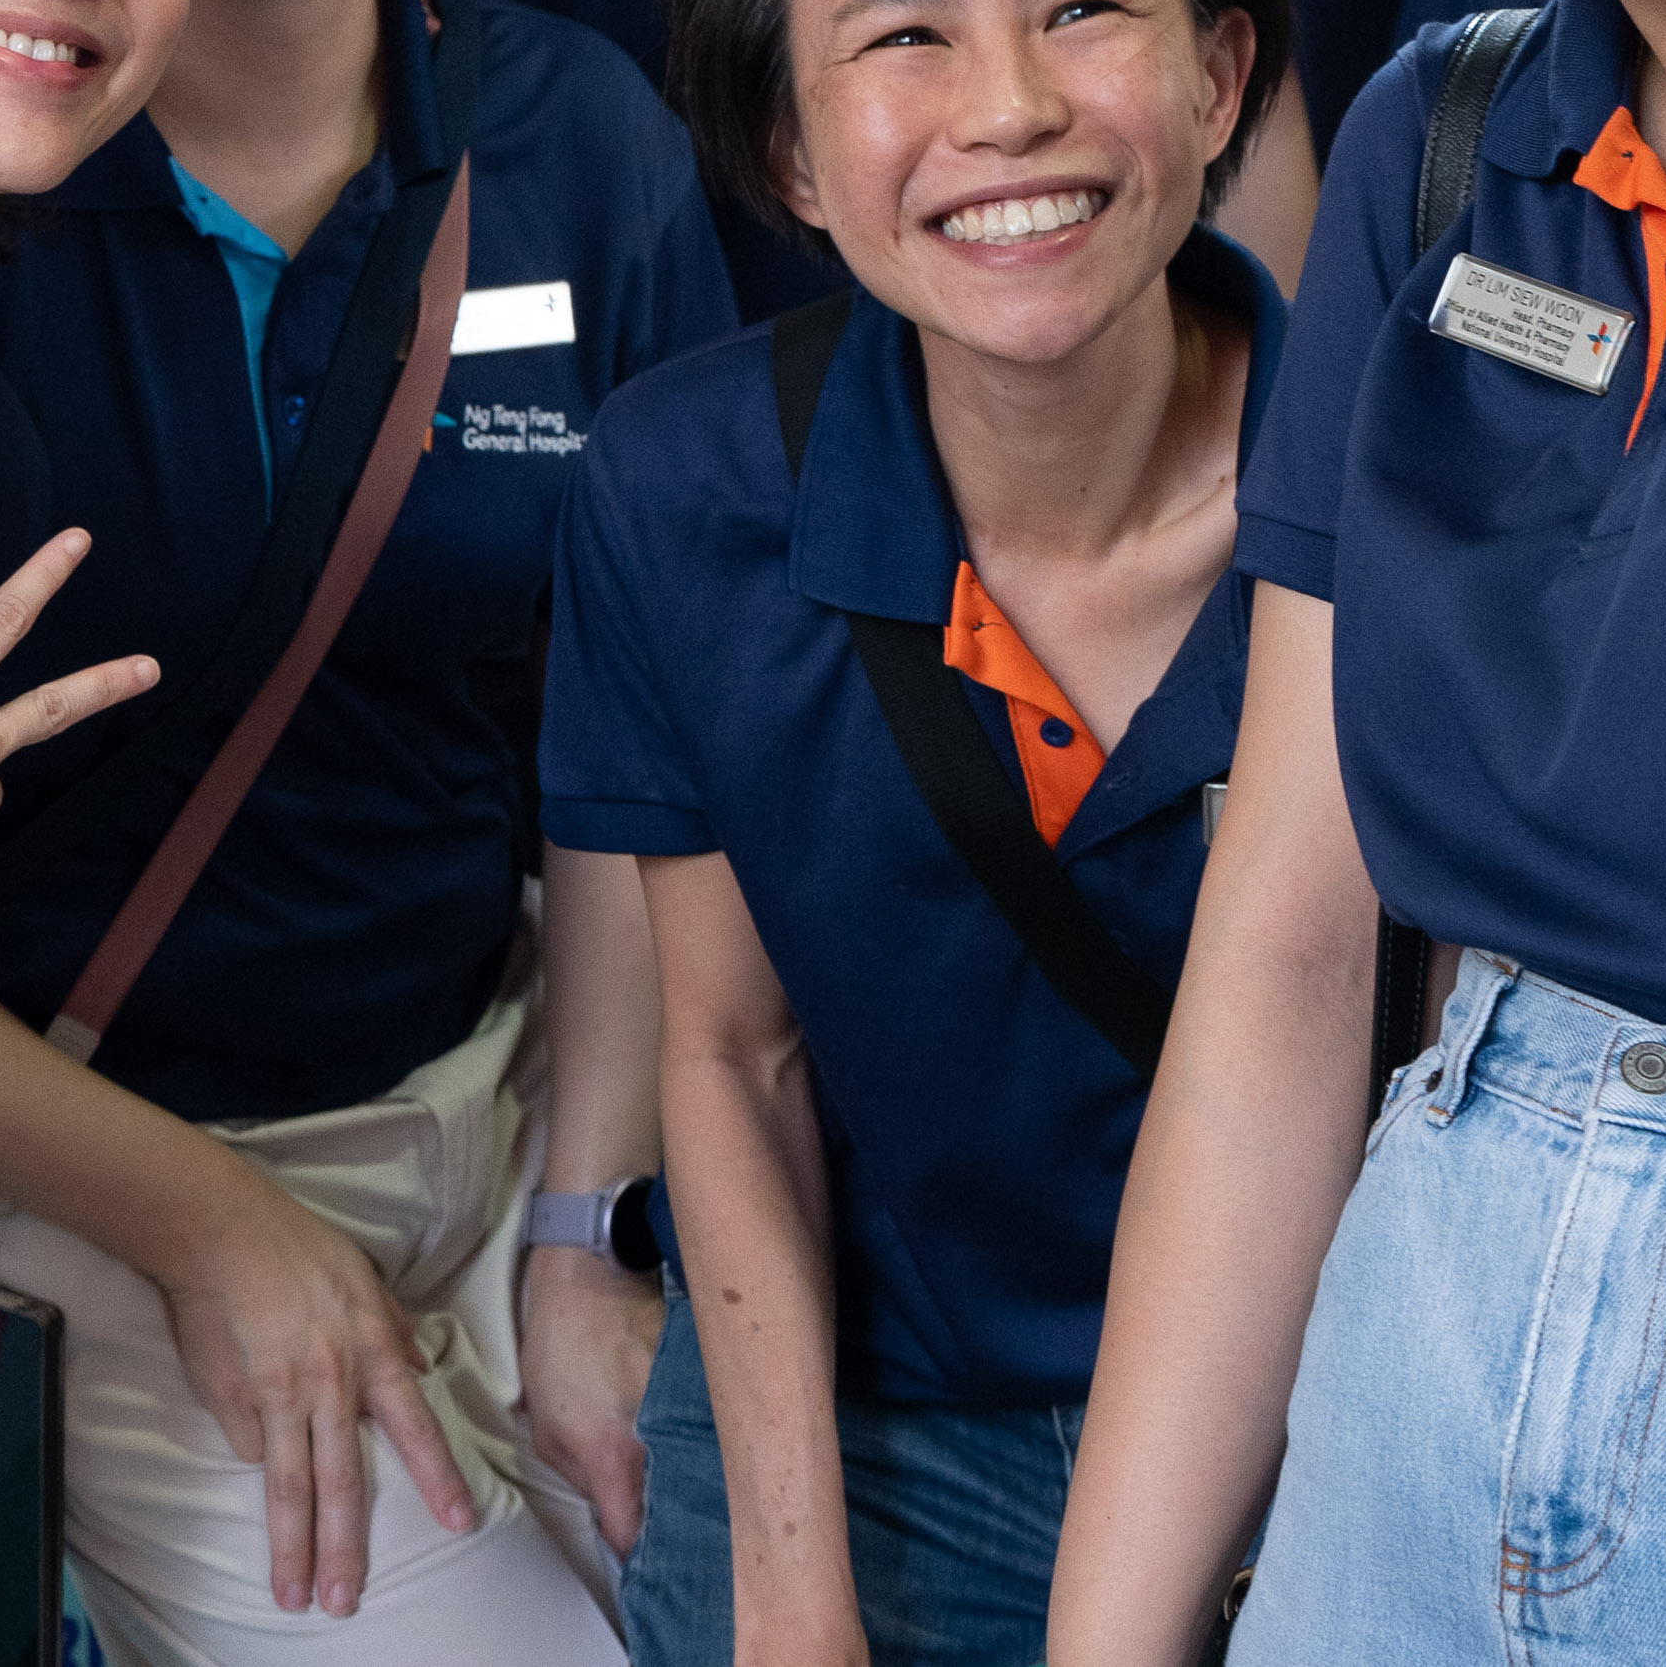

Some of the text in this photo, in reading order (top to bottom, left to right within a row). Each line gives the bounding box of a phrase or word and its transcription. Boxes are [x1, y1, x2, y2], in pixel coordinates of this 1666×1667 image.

[1466, 270, 1486, 290] DR
[1485, 277, 1511, 298] LIM
[1544, 298, 1585, 325] WOON
[464, 403, 566, 434] Ng Teng Fong
[462, 427, 527, 453] General
